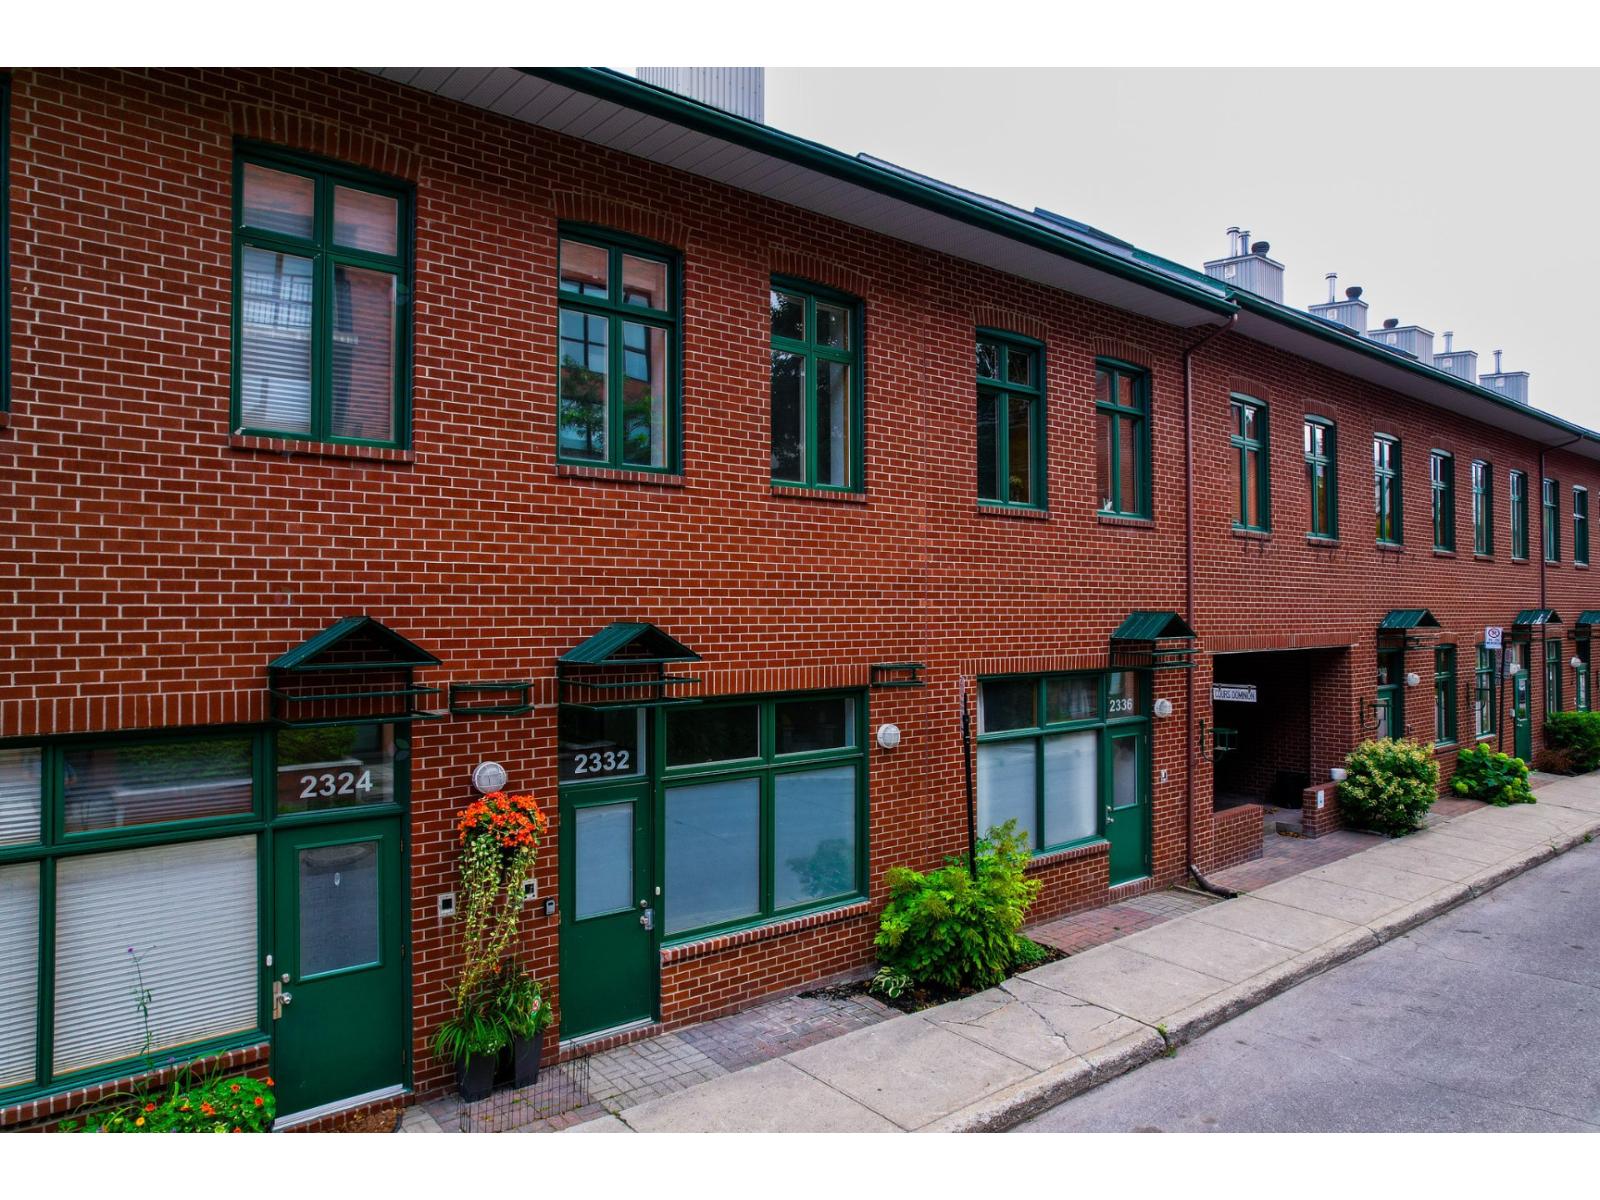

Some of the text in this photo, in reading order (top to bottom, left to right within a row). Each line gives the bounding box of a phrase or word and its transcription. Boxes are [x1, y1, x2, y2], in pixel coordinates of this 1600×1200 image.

[1109, 698, 1133, 712] 2336
[574, 750, 630, 774] 2332
[299, 770, 373, 799] 2324
